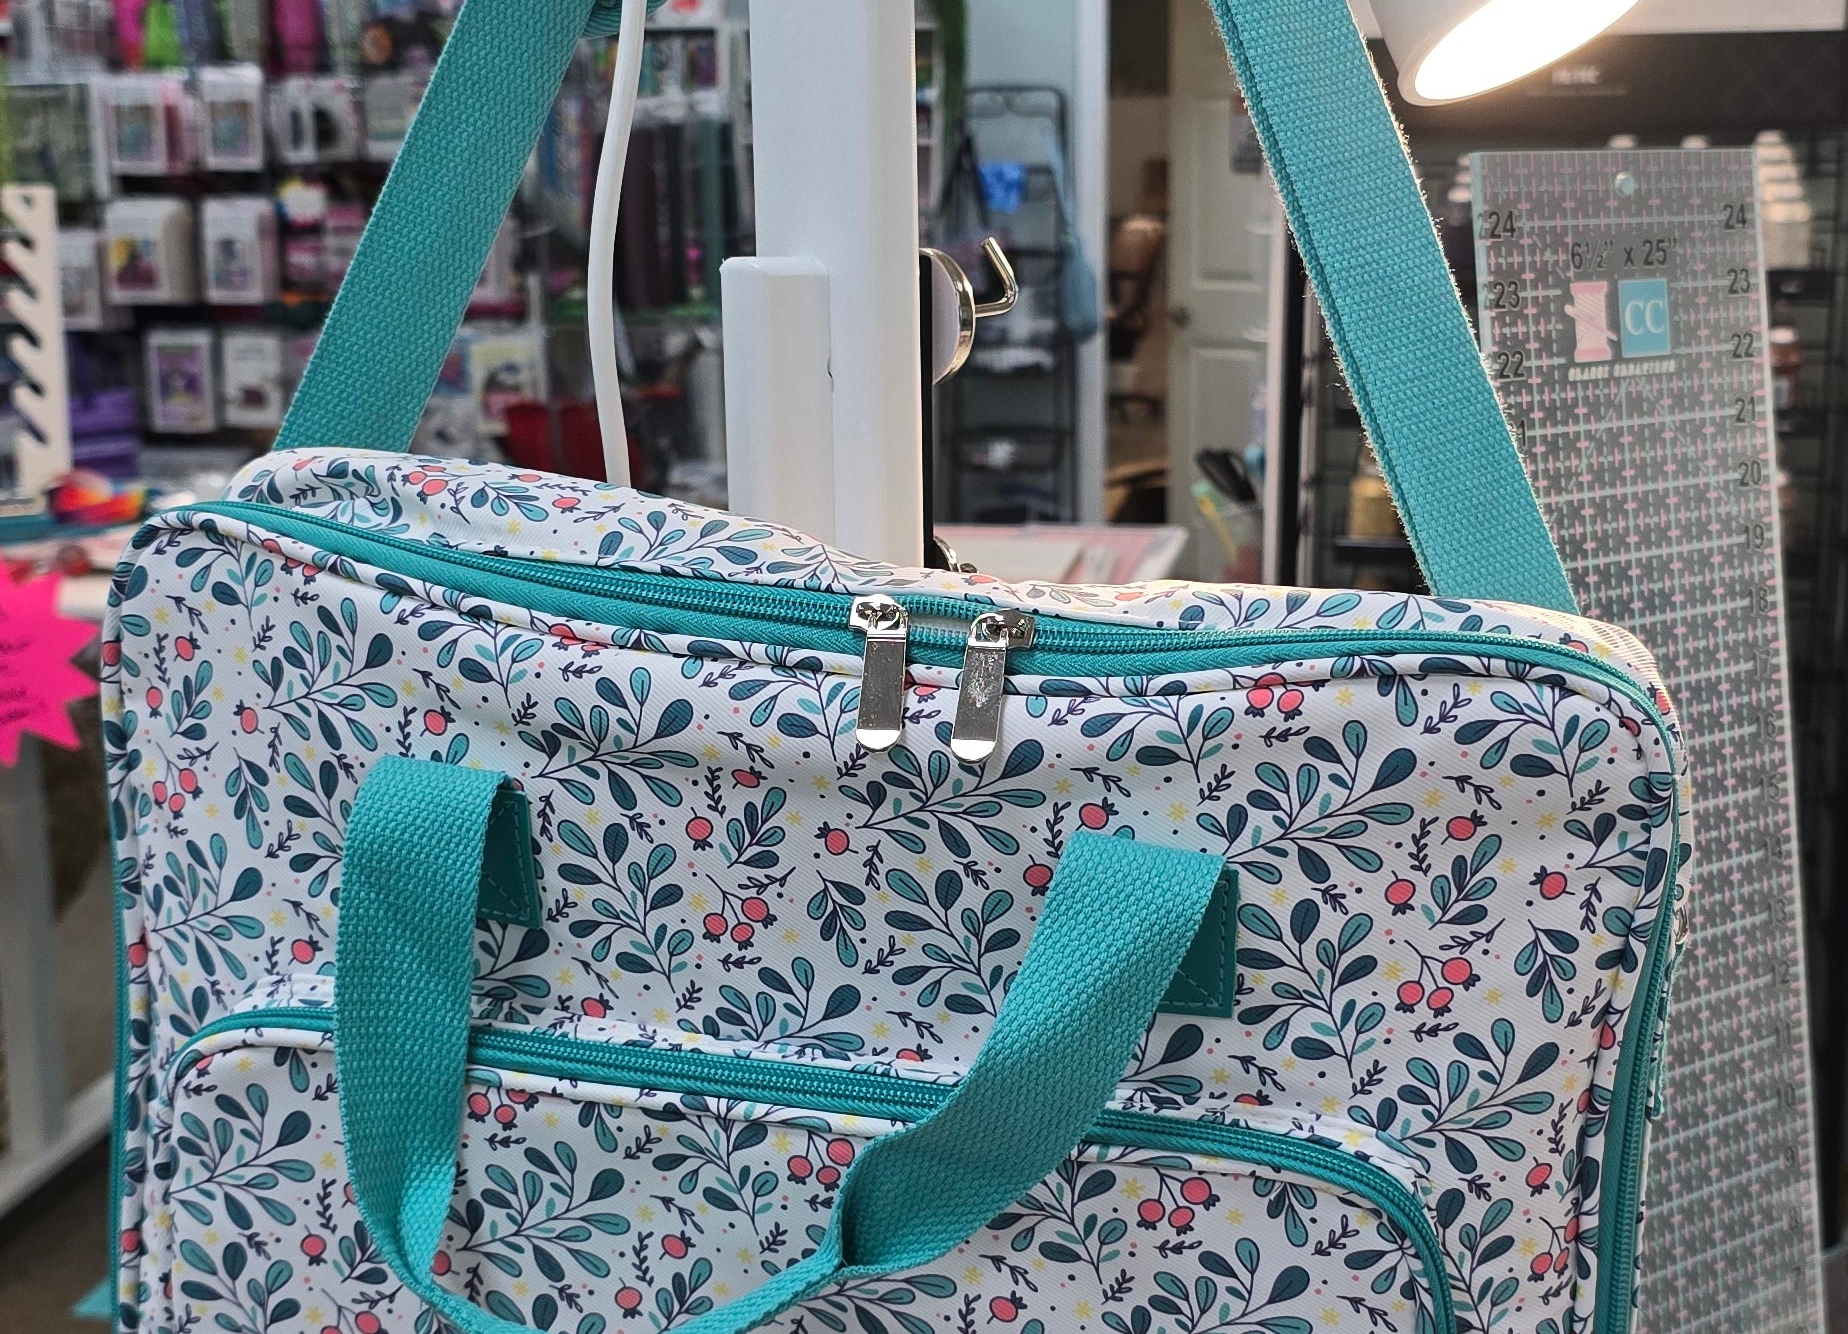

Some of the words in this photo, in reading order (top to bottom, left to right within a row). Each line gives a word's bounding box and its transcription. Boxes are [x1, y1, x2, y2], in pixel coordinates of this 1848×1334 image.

[1489, 211, 1516, 240] 24
[1723, 204, 1747, 230] 24
[1493, 281, 1521, 309] 23
[1727, 268, 1751, 295] 23
[1624, 300, 1664, 335] CC
[1731, 332, 1755, 359] 22
[1498, 351, 1525, 379] 22
[1734, 396, 1757, 423] 21
[1738, 460, 1762, 487] 20
[1743, 524, 1766, 552] 19
[1747, 586, 1769, 616] 18
[1755, 711, 1777, 740] 16
[1759, 774, 1780, 801] 15
